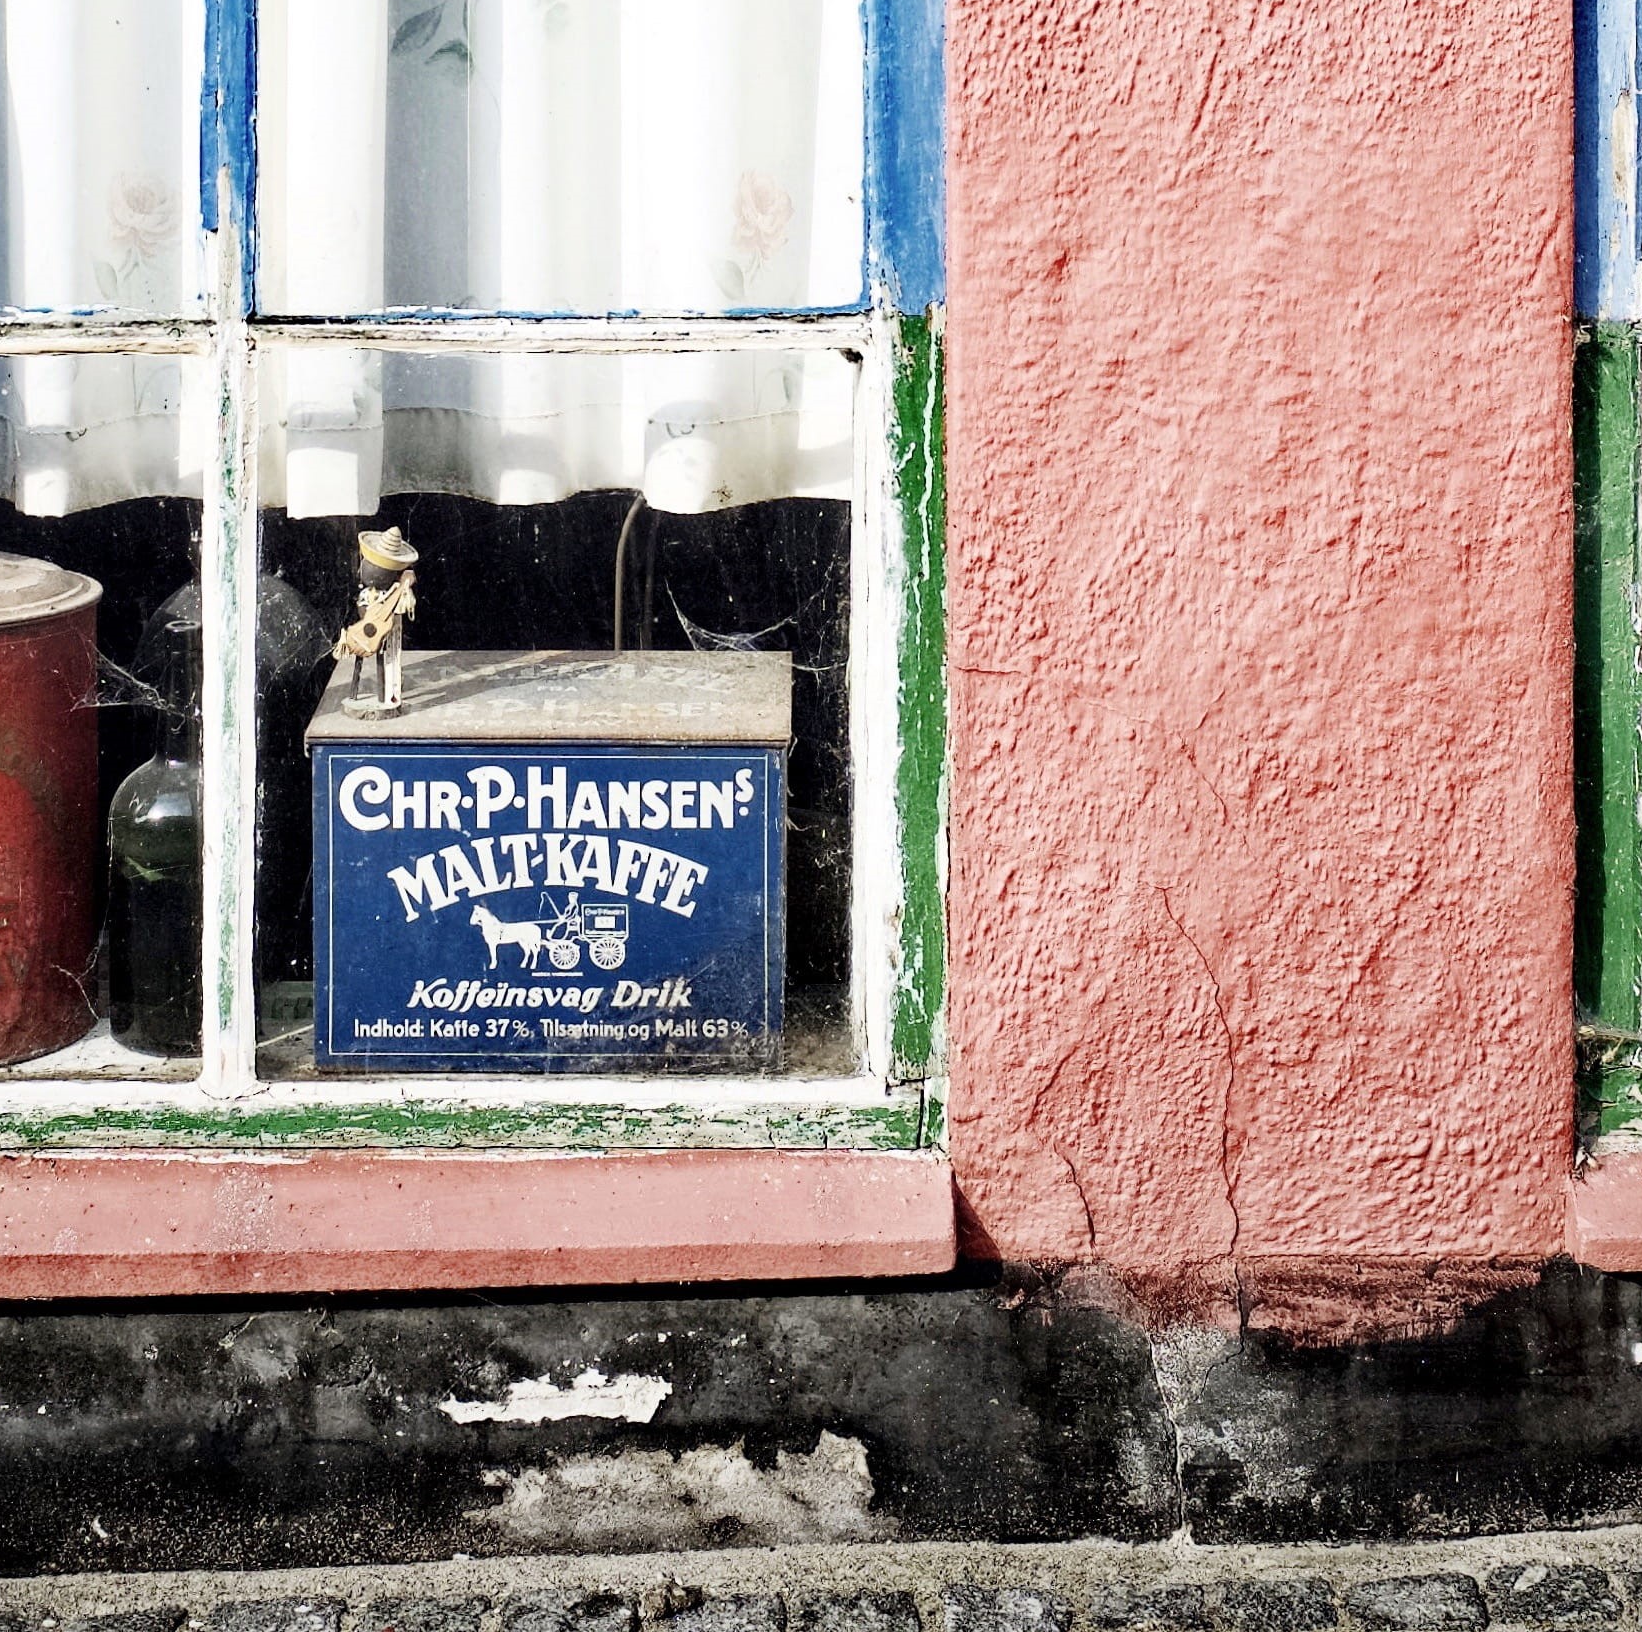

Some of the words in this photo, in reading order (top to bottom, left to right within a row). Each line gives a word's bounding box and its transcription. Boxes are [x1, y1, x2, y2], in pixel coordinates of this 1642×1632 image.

[386, 832, 709, 923] MALT-KAFFE
[609, 978, 693, 1008] Drik
[354, 1019, 425, 1037] Indhold:
[430, 1019, 480, 1037] Kaffe
[628, 1024, 649, 1040] og
[656, 1019, 698, 1037] Malt
